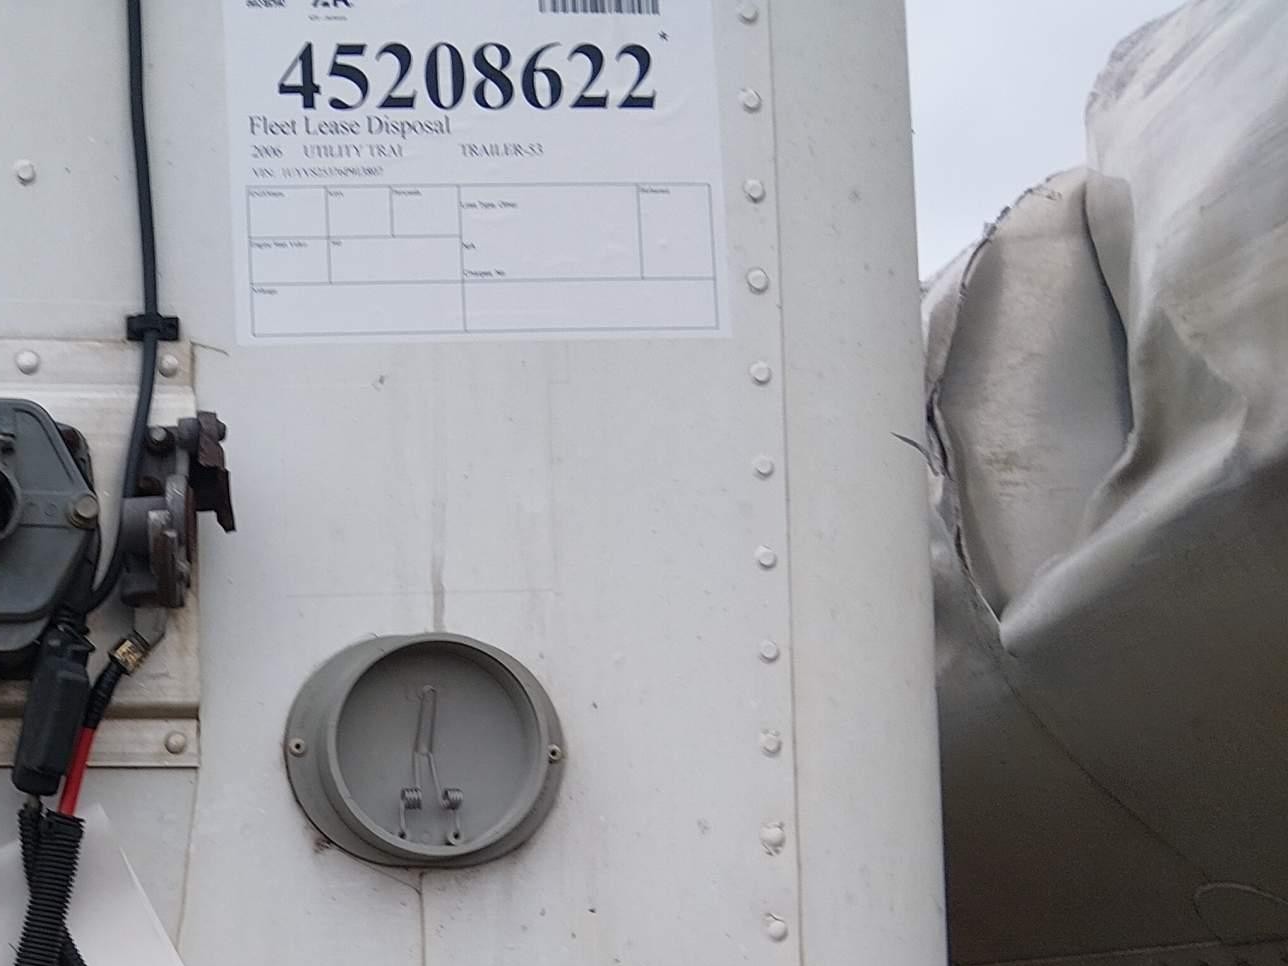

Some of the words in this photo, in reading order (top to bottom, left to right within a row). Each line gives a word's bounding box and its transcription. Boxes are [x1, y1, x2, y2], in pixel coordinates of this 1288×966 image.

[277, 41, 657, 111] 45208622
[249, 115, 298, 136] Fleet
[303, 115, 361, 136] Lease
[366, 114, 453, 140] Disposal
[250, 144, 283, 159] 2006
[302, 143, 362, 158] UTILITY
